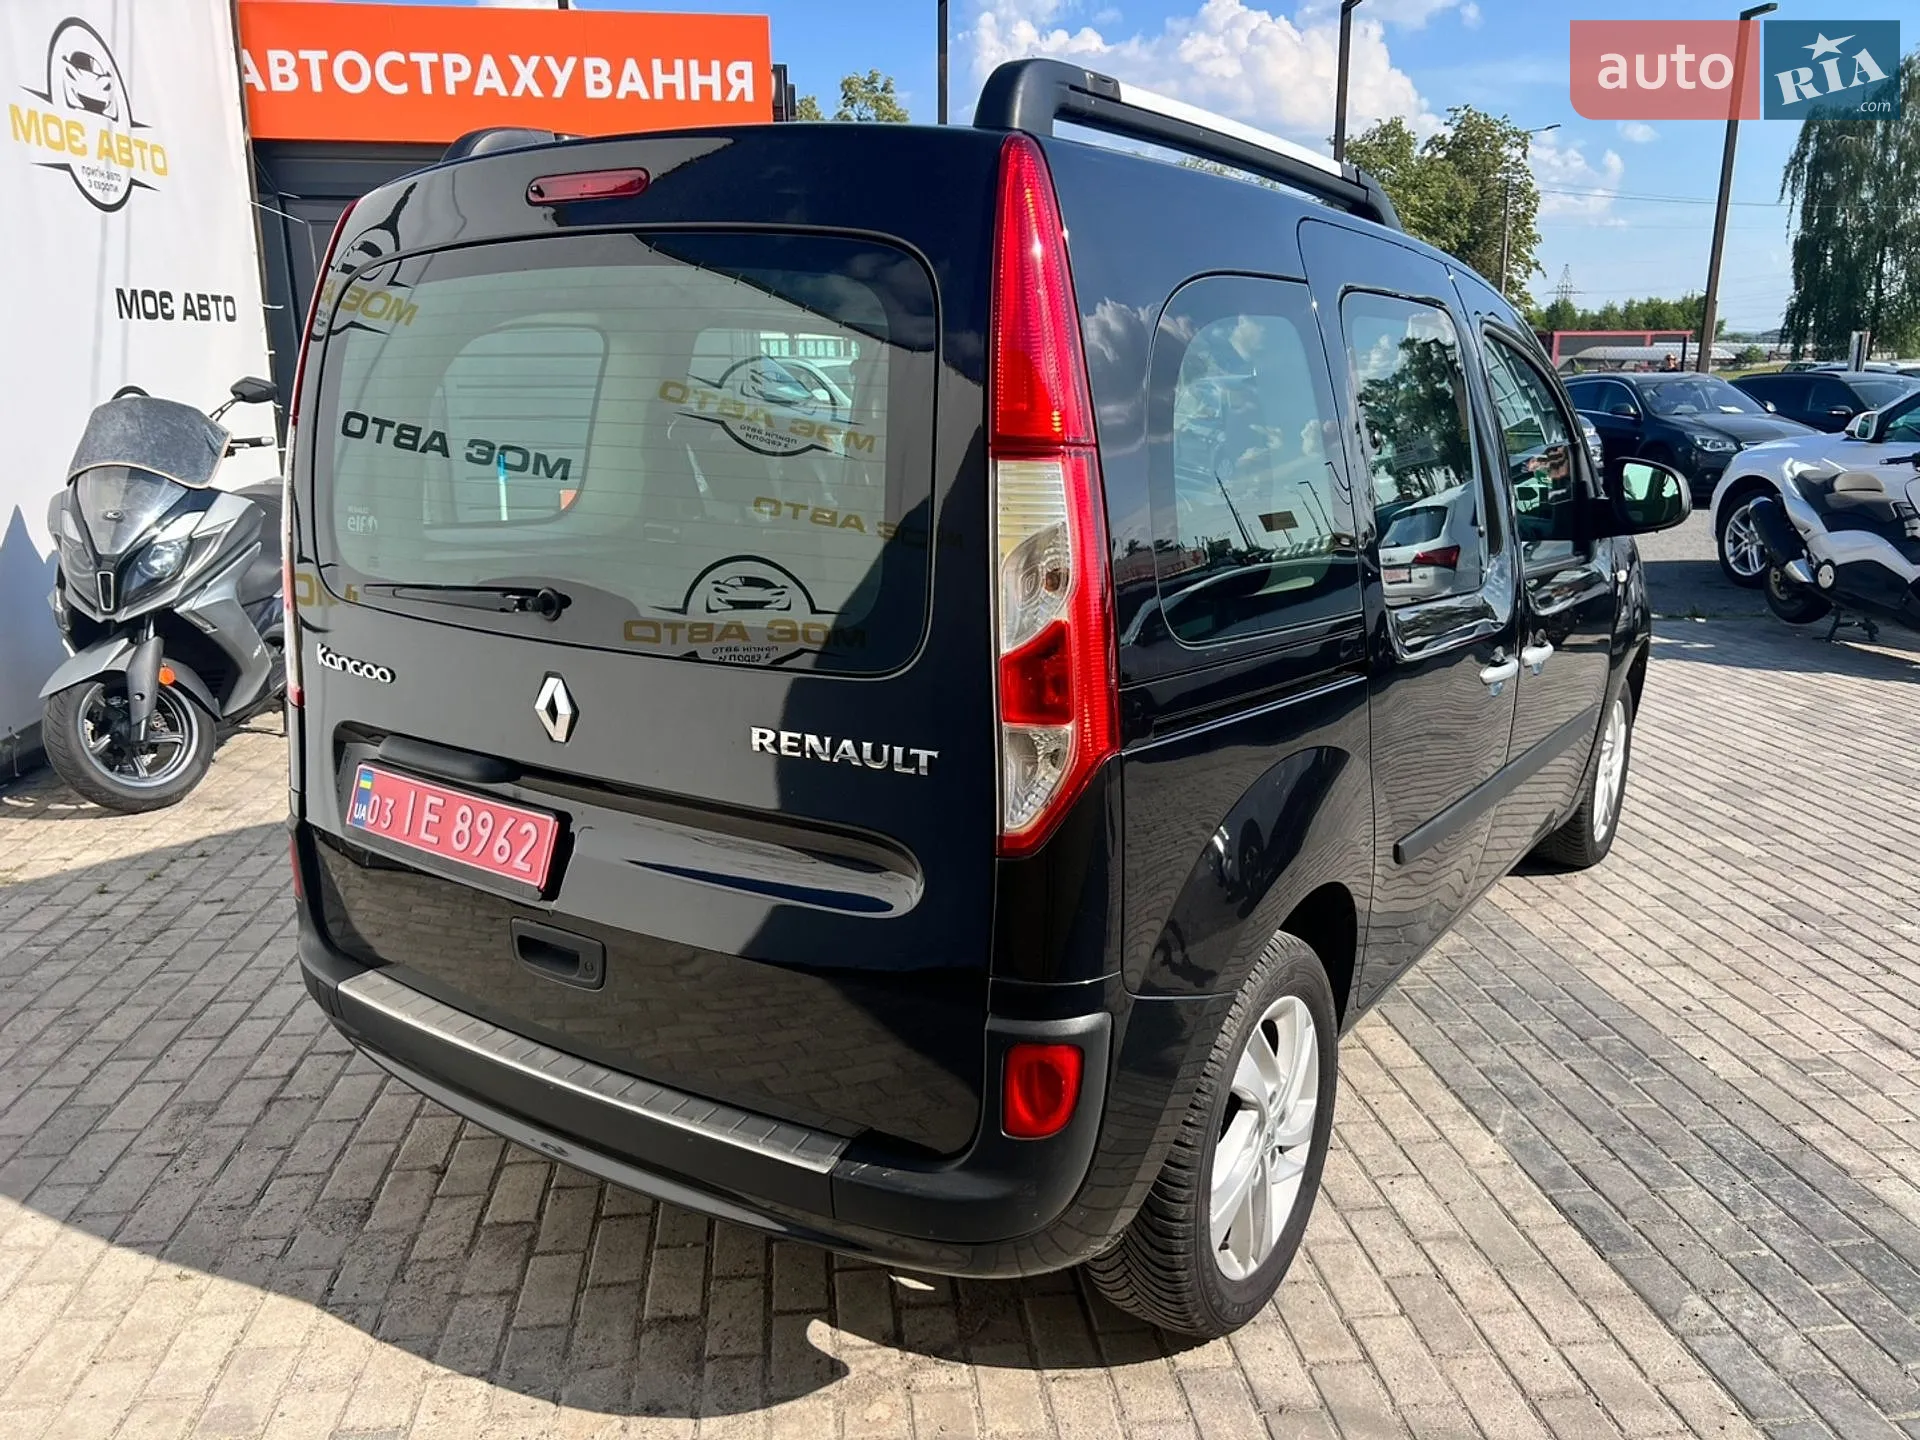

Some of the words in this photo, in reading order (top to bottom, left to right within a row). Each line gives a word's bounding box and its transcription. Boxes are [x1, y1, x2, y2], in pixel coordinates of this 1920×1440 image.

[242, 48, 754, 102] АВТОСТРАХУВАННЯ
[8, 103, 88, 157] МОЄ
[97, 128, 168, 176] АВТО
[115, 287, 175, 321] МОЄ
[182, 292, 237, 322] АВТО
[316, 642, 395, 683] Kangoo
[750, 726, 940, 776] RENAULT
[354, 802, 366, 821] UA
[367, 795, 396, 830] 03
[451, 804, 540, 873] 8962
